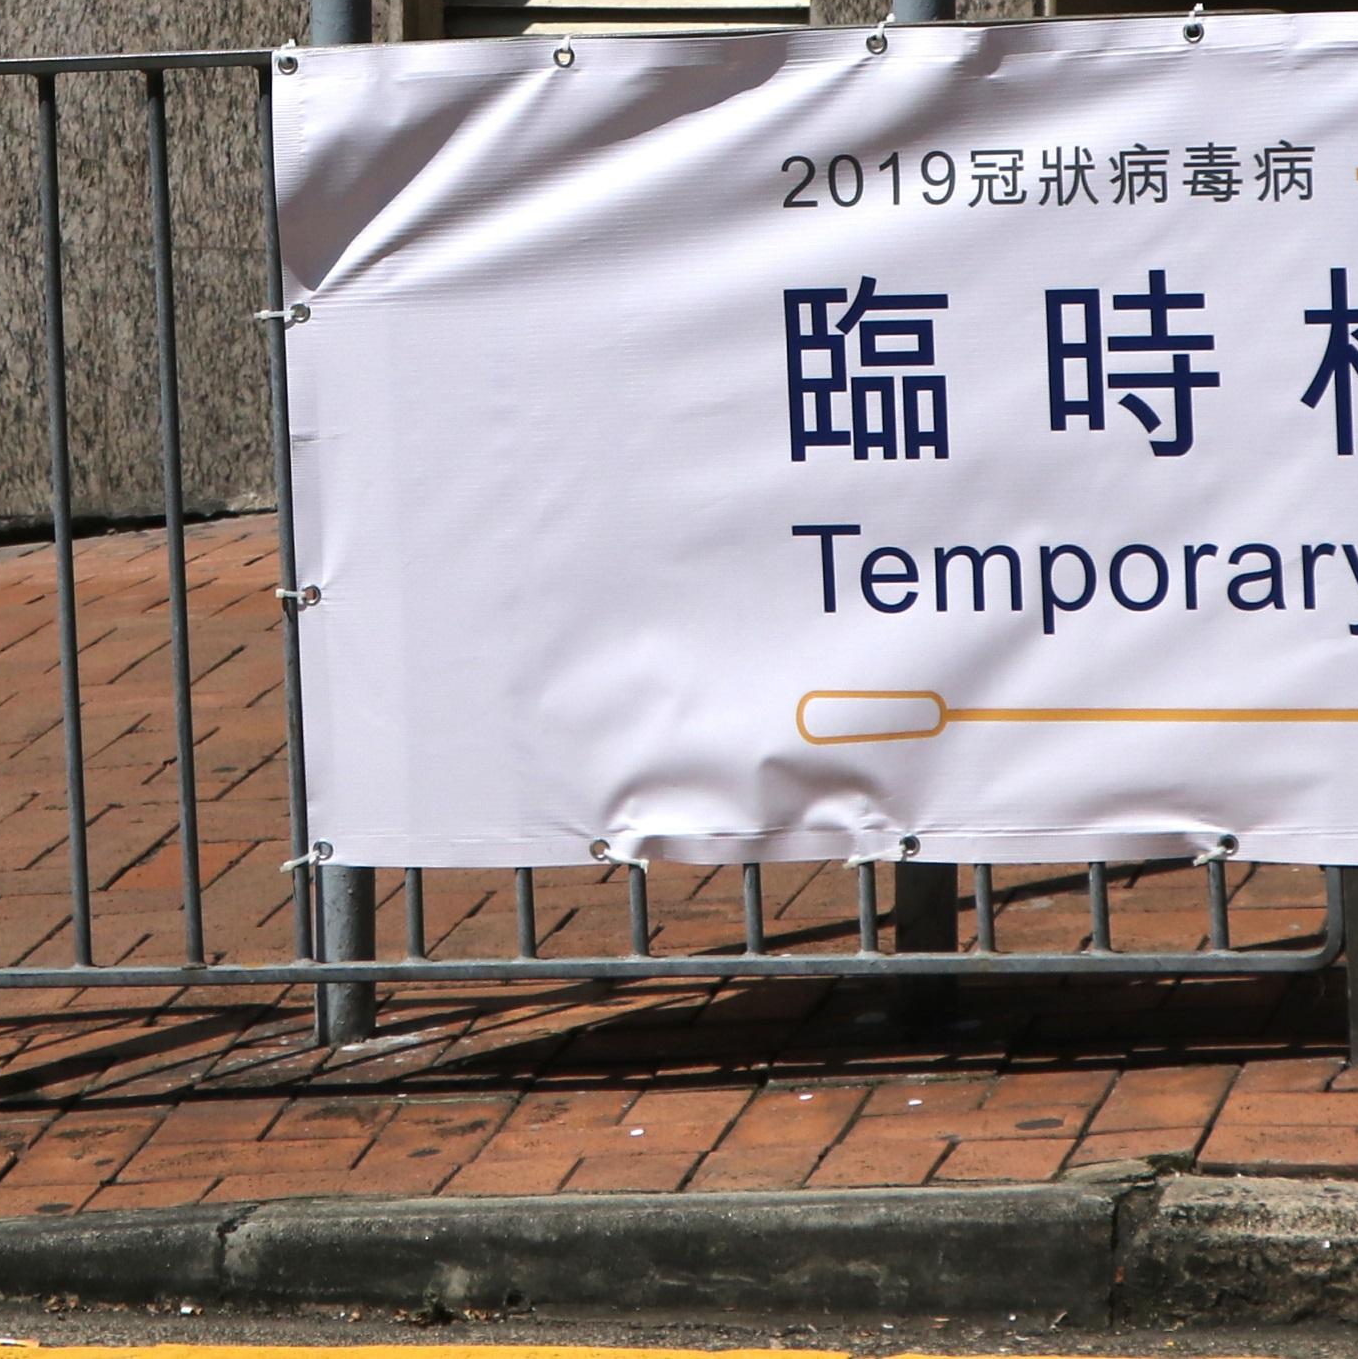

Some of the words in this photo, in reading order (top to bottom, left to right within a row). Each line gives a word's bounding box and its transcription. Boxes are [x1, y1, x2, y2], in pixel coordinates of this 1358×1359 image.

[781, 138, 1318, 210] 2019冠狀病毒病
